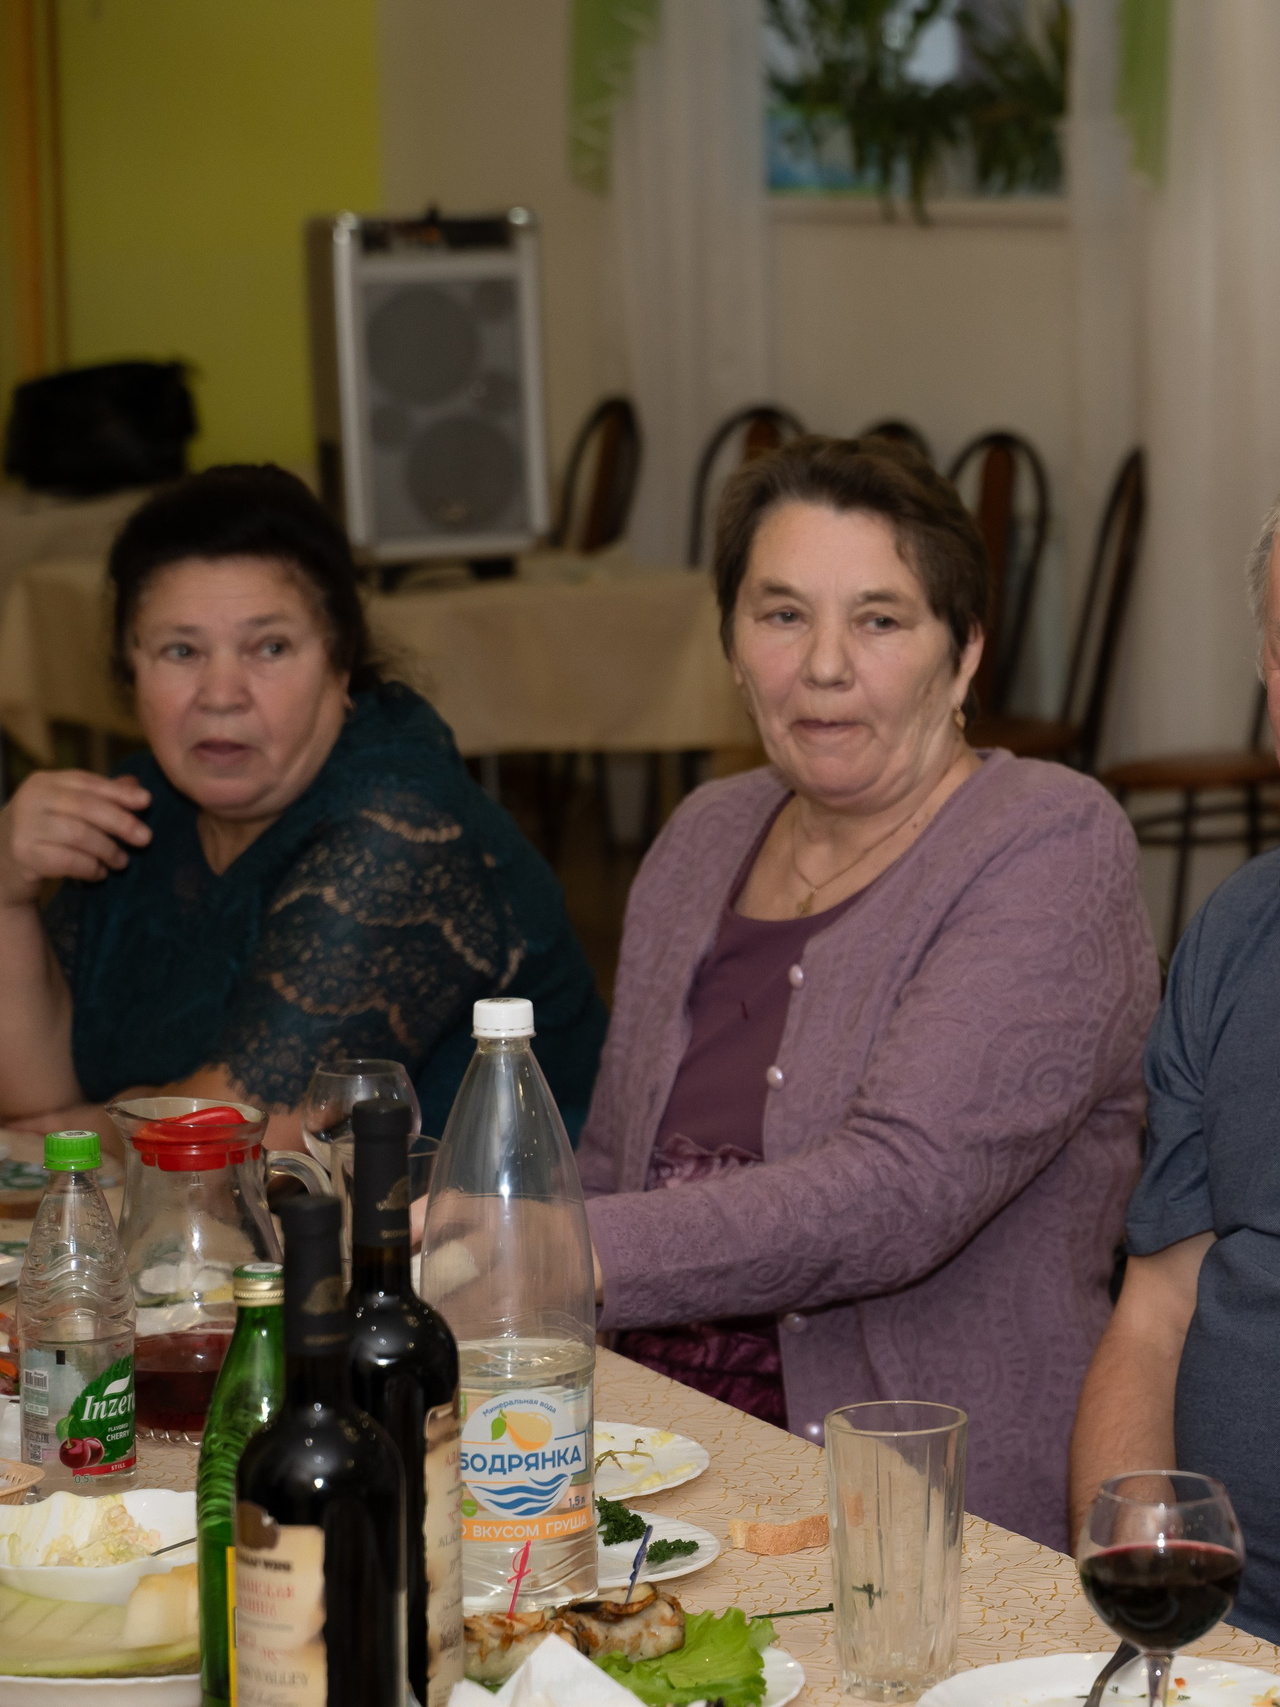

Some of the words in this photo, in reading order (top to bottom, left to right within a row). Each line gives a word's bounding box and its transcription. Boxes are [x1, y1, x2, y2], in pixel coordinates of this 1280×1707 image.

[482, 1398, 539, 1417] Минеральная
[540, 1400, 557, 1414] вода
[106, 1430, 130, 1442] CHERRY
[111, 1463, 126, 1471] STILL
[473, 1524, 539, 1539] ВКУСОМ
[545, 1514, 588, 1536] ГРУША
